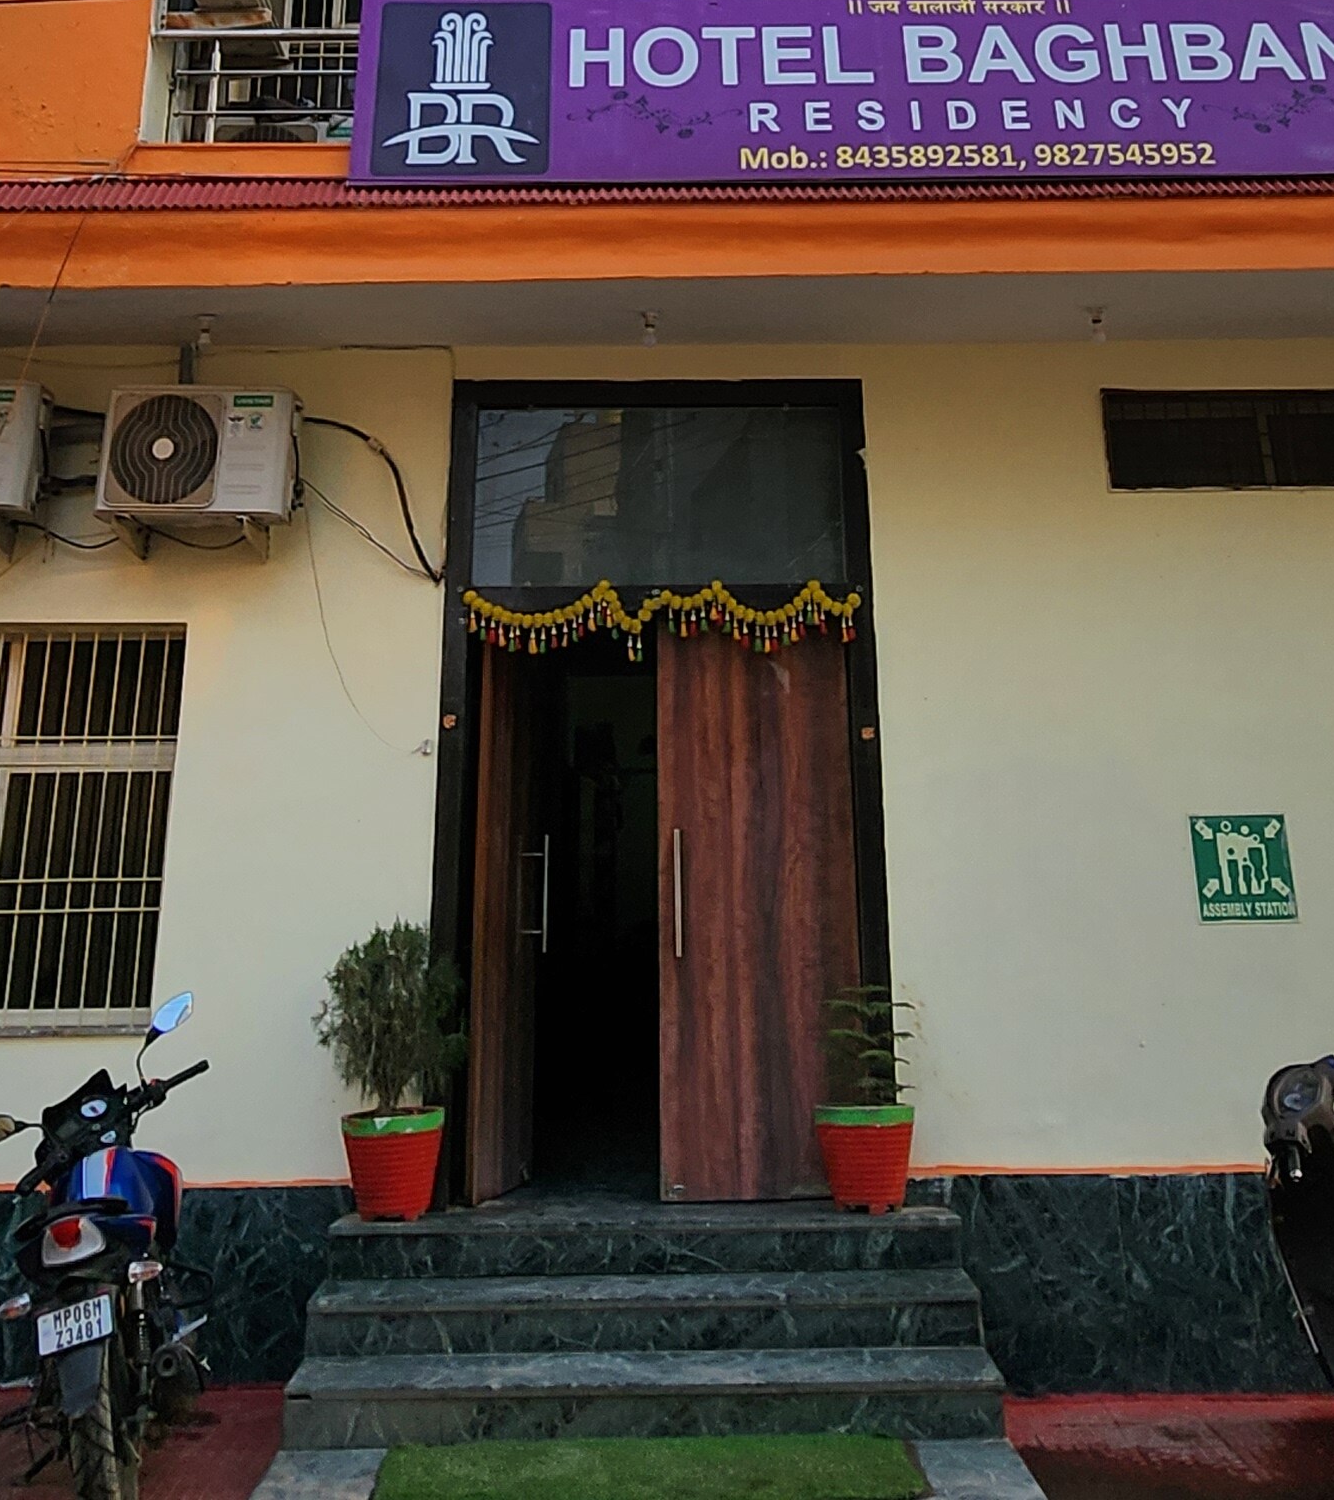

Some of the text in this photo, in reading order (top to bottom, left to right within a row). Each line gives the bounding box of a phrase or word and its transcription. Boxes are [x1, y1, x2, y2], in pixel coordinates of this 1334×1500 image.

[868, 0, 900, 15] जय
[982, 0, 1046, 15] सरकार
[567, 26, 875, 88] HOTEL
[748, 98, 1193, 133] RESIDENCY
[739, 143, 1216, 171] Mob.: 8435892581, 9827545952
[1203, 902, 1296, 917] ASSEMBLY STATION
[53, 1299, 102, 1330] MP06M
[55, 1317, 103, 1348] Z3481
